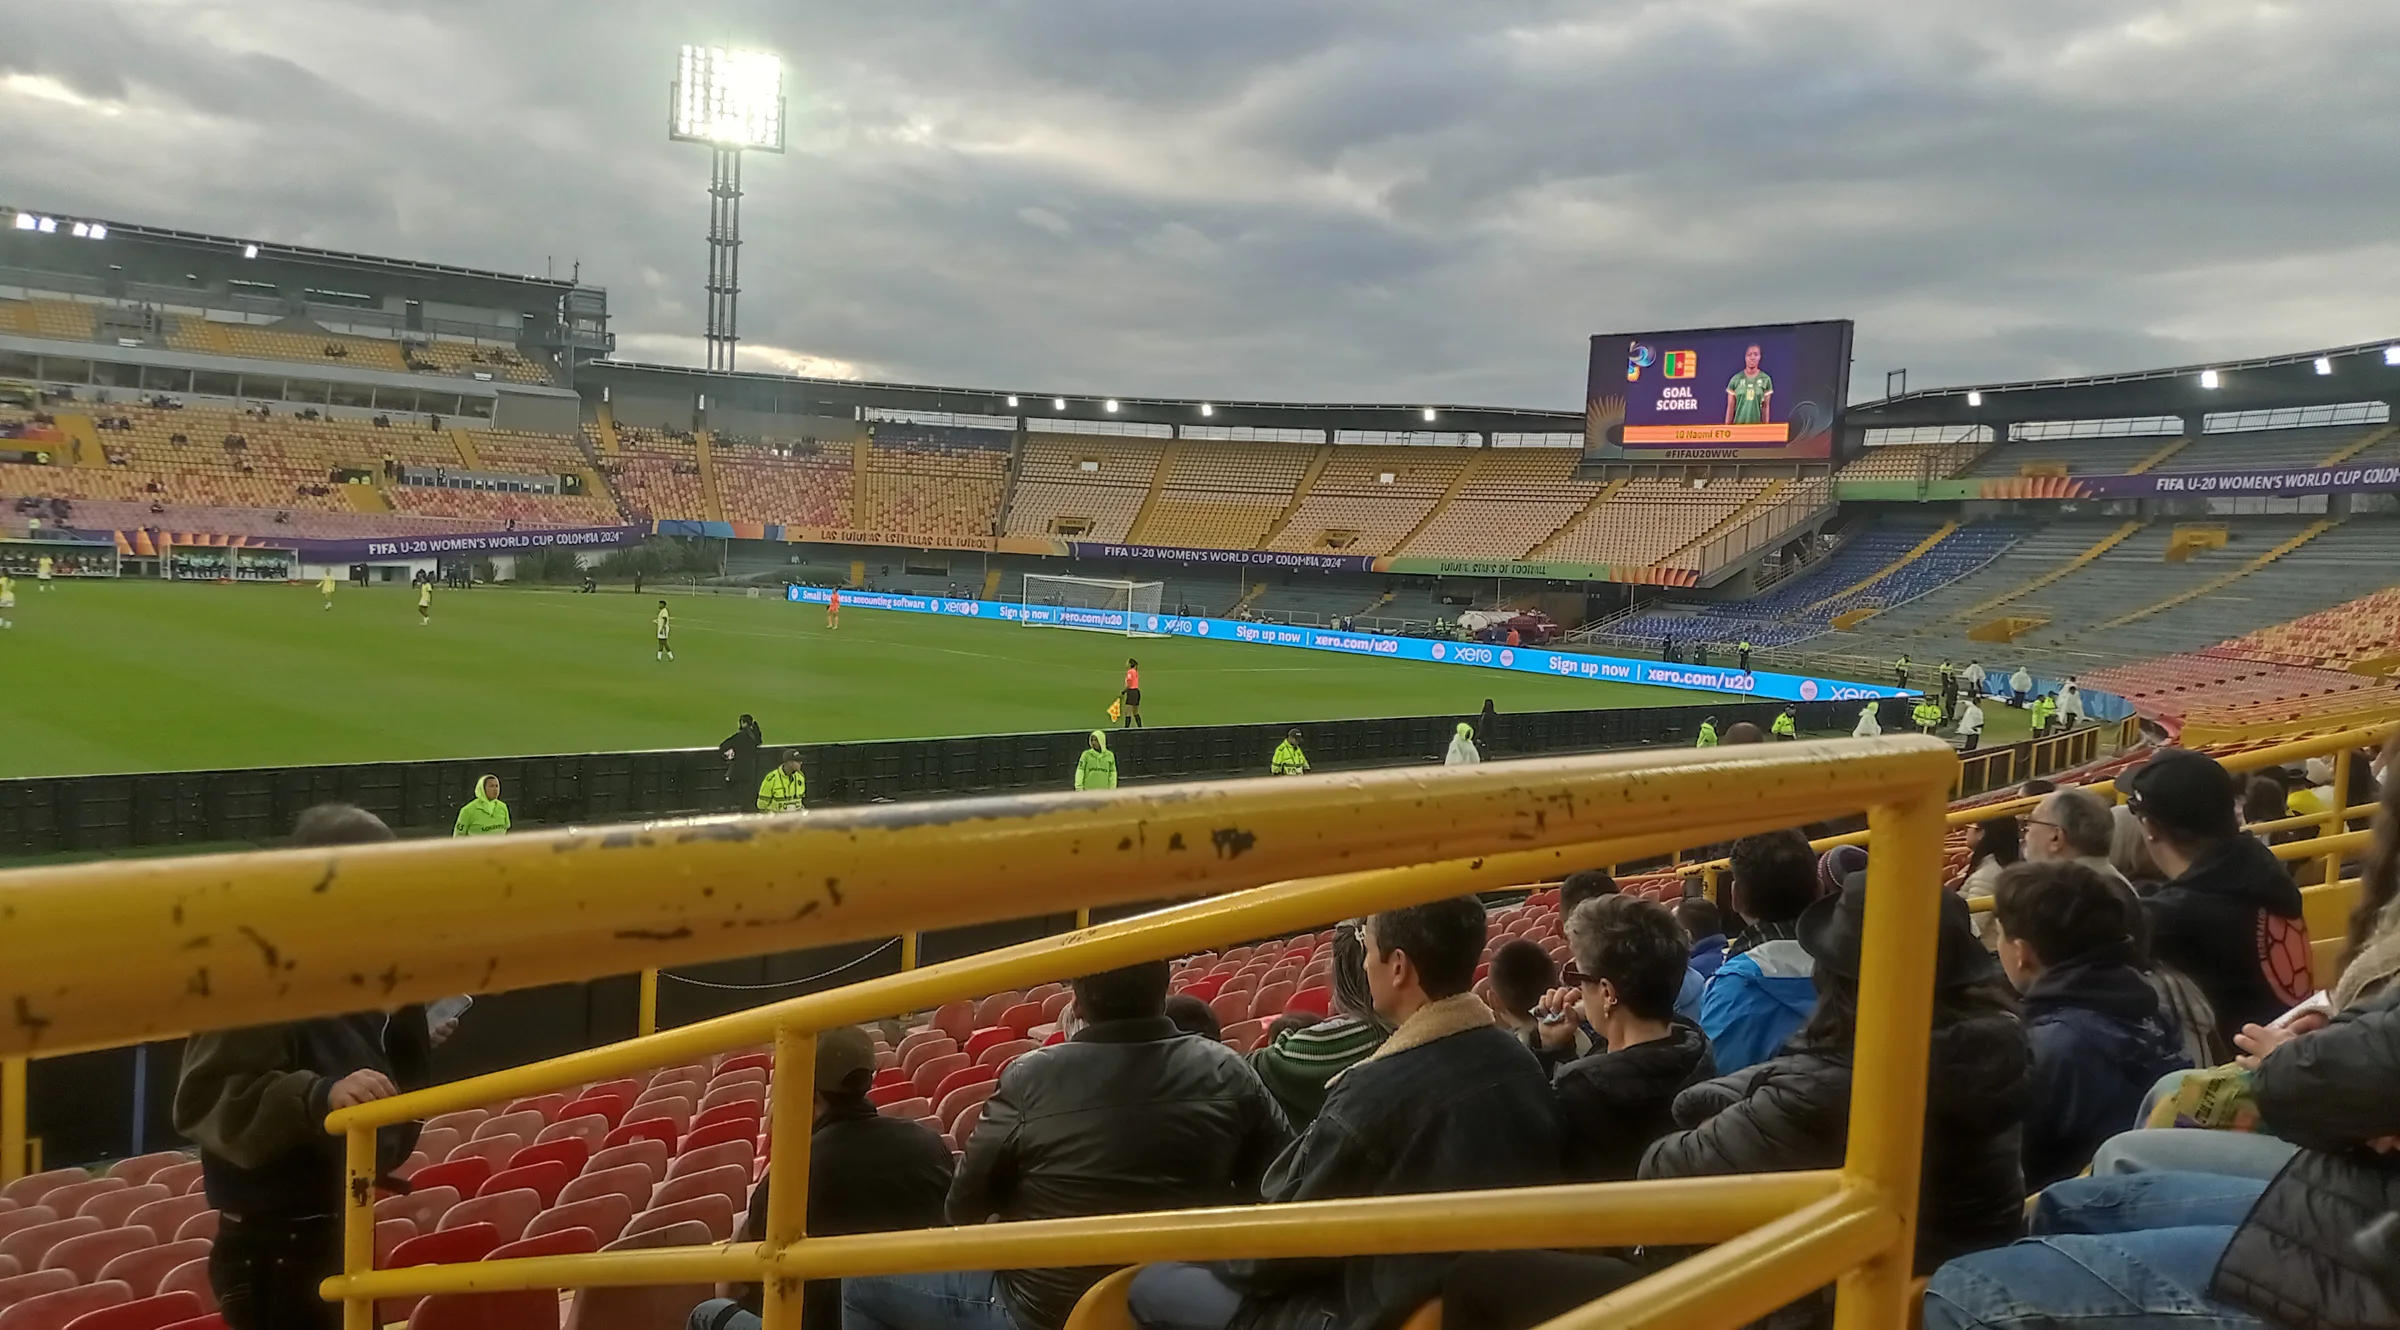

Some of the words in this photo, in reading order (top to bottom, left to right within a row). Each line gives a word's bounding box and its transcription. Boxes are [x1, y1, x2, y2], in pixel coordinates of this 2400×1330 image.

[1663, 387, 1692, 398] GOAL
[1656, 399, 1698, 411] SCORER
[1715, 430, 1731, 438] ETO
[1665, 449, 1739, 459] #FIFAU20WWC
[2156, 477, 2185, 491] FIFA
[2187, 477, 2216, 490] U-20
[2218, 474, 2282, 490] WOMEN'S
[2285, 472, 2331, 487] WORLD
[2333, 470, 2361, 485] CUP
[368, 543, 398, 555] FIFA
[400, 541, 427, 553] U-20
[429, 537, 487, 551] WOMEN'S
[488, 536, 530, 549] WORLD
[532, 535, 554, 546] CUP
[556, 532, 599, 545] COLOMBIA
[821, 530, 838, 540] LAS
[1104, 546, 1129, 557] FIFA
[1131, 547, 1155, 558] U-20
[1156, 549, 1208, 561] WOMEN'S
[1209, 551, 1249, 563] WORLD
[1251, 553, 1273, 565] CUP
[1275, 555, 1319, 567] COLOMBIA
[803, 590, 822, 601] Small
[822, 591, 852, 603] buess
[853, 595, 892, 609] accounting
[893, 597, 926, 609] software
[999, 605, 1018, 620] Sign
[1031, 610, 1050, 620] now
[1060, 612, 1123, 626] xero.com/u20
[1236, 625, 1260, 642] Sign
[1261, 631, 1276, 643] up
[1278, 632, 1301, 643] now
[1314, 634, 1398, 653] xero.com/u20
[1453, 646, 1493, 663] xero
[1549, 655, 1578, 675] Sign
[1581, 663, 1599, 677] up
[1601, 664, 1630, 678] now
[1647, 668, 1755, 691] xero.com/u20
